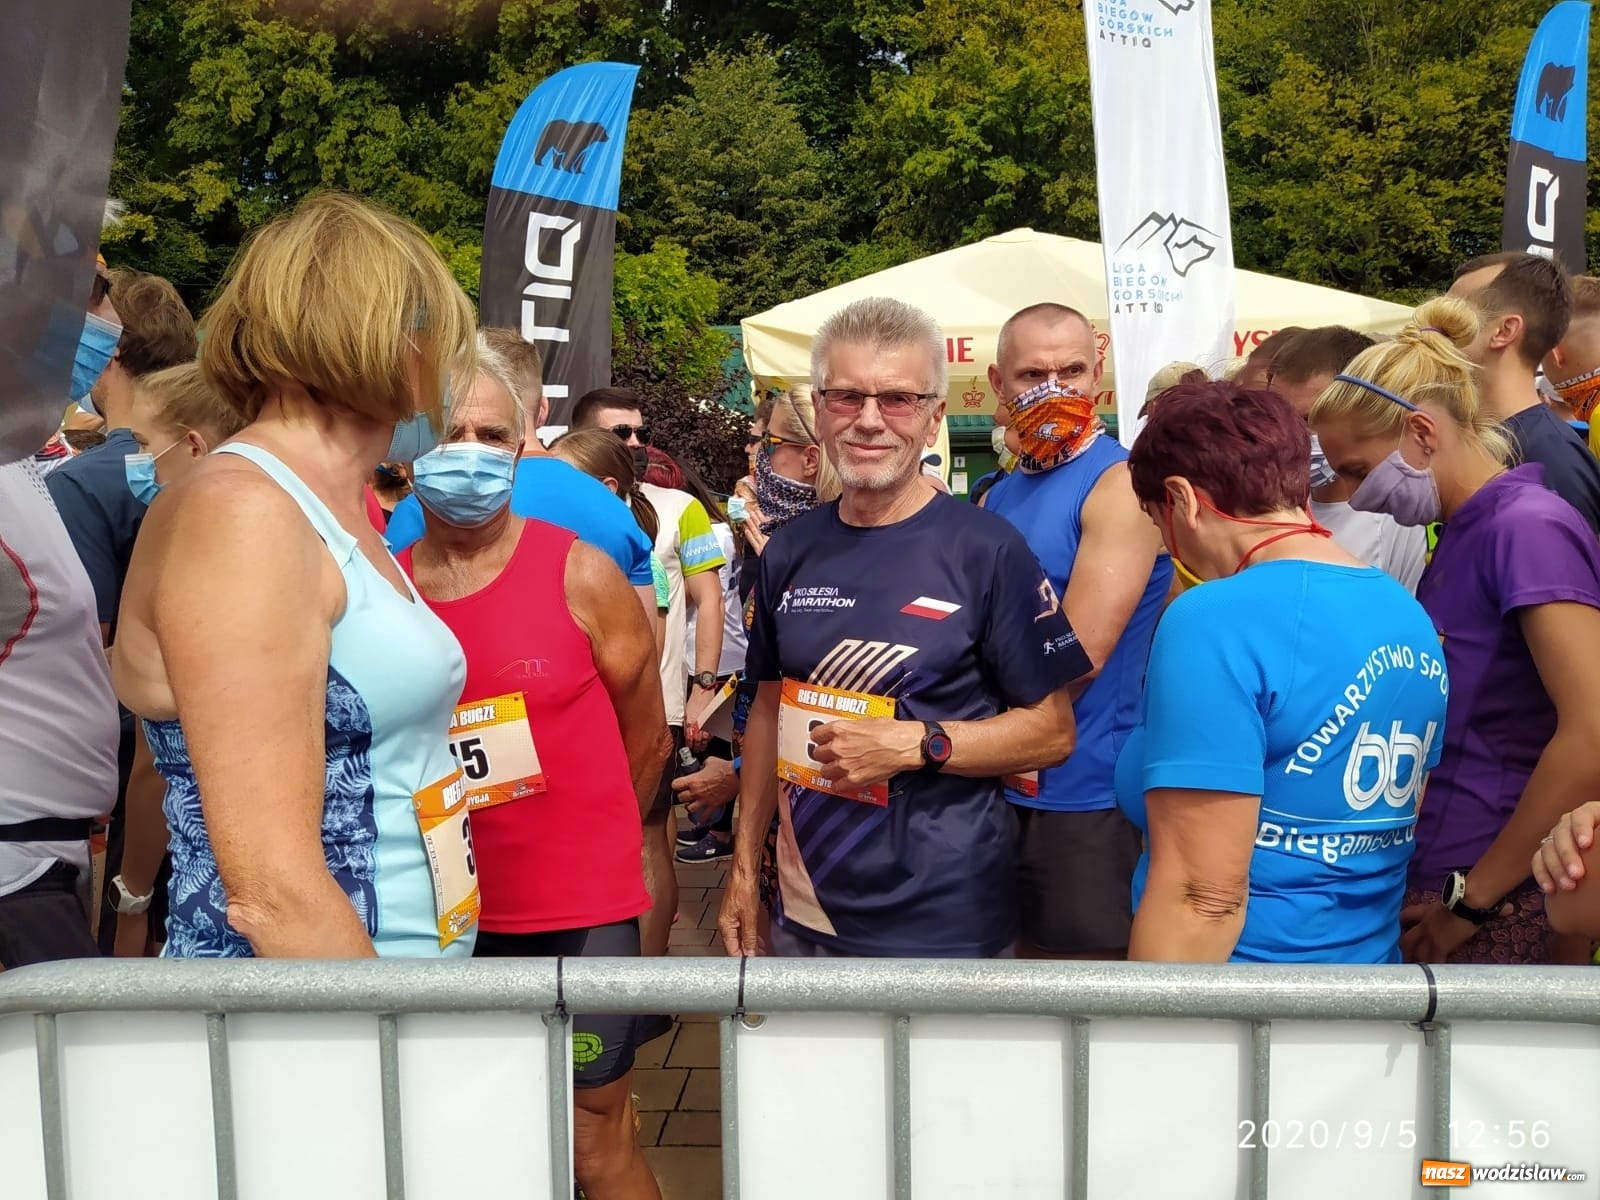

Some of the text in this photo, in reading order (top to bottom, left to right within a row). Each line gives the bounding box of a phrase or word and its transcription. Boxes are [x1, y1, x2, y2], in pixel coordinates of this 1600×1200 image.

[1100, 29, 1151, 48] ATTIQ
[792, 598, 856, 607] MARATHON
[797, 688, 869, 715] BIEG NA BUCZE
[1285, 644, 1448, 776] TOWARZYSTWO SPO
[459, 704, 497, 726] BUCZE
